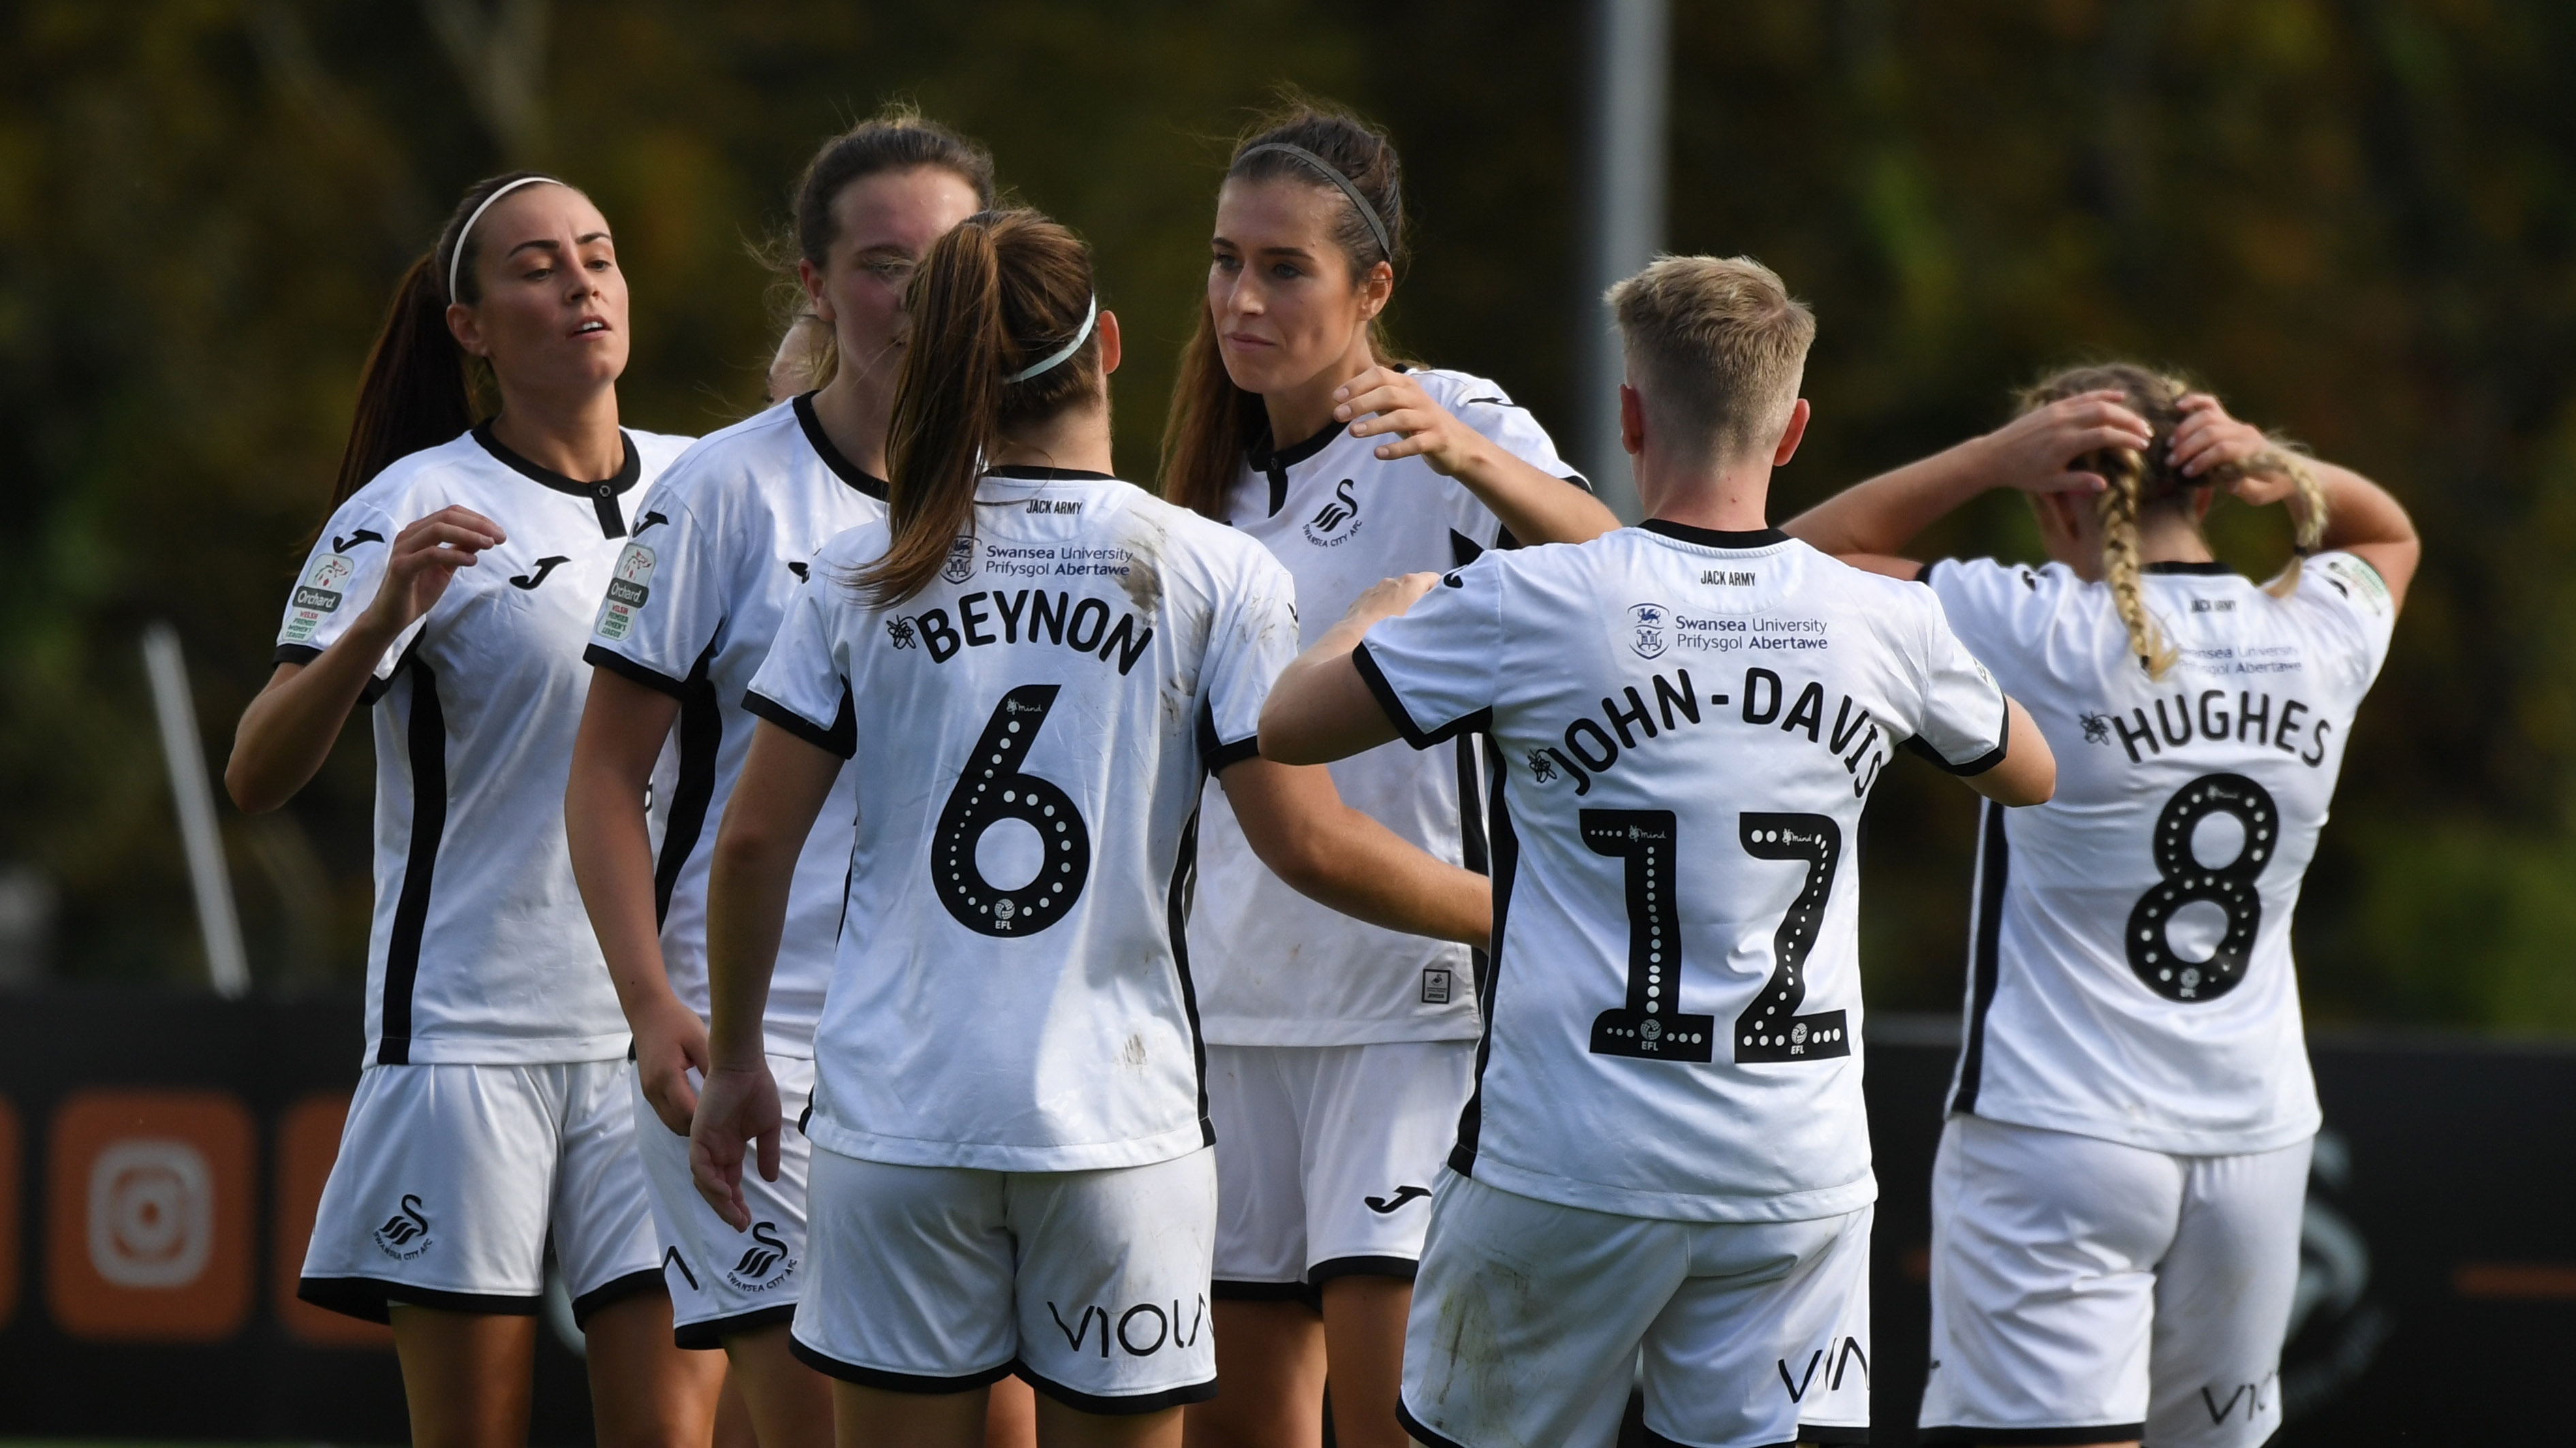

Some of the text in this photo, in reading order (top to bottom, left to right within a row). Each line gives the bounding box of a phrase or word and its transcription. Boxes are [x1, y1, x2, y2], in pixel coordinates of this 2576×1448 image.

[1026, 500, 1083, 515] JACK ARMY
[1303, 519, 1363, 548] SWANSEA CITY AFC
[986, 546, 1134, 563] Swansea University
[986, 561, 1130, 578] Prifysgol Abertawe
[1701, 570, 1756, 586] JACK ARMY
[297, 590, 337, 608] Orchard
[610, 582, 642, 603] Orchard
[917, 589, 1153, 676] BEYNON
[1675, 615, 1828, 635] Swansea University
[1677, 633, 1829, 652] Prifysgol Abertawe
[1547, 666, 1883, 798] JOHN-DAVIS
[2113, 689, 2331, 768] HUGHES
[931, 684, 1090, 938] 6
[2124, 772, 2280, 1005] 8
[995, 920, 1012, 930] EFL
[1579, 808, 1852, 1064] 12
[1641, 1041, 1659, 1052] EFL
[1790, 1045, 1805, 1055] EFL
[403, 1250, 420, 1261] CITY
[420, 1238, 433, 1255] AFC
[727, 1259, 797, 1292] SWANSEA CITY AFC
